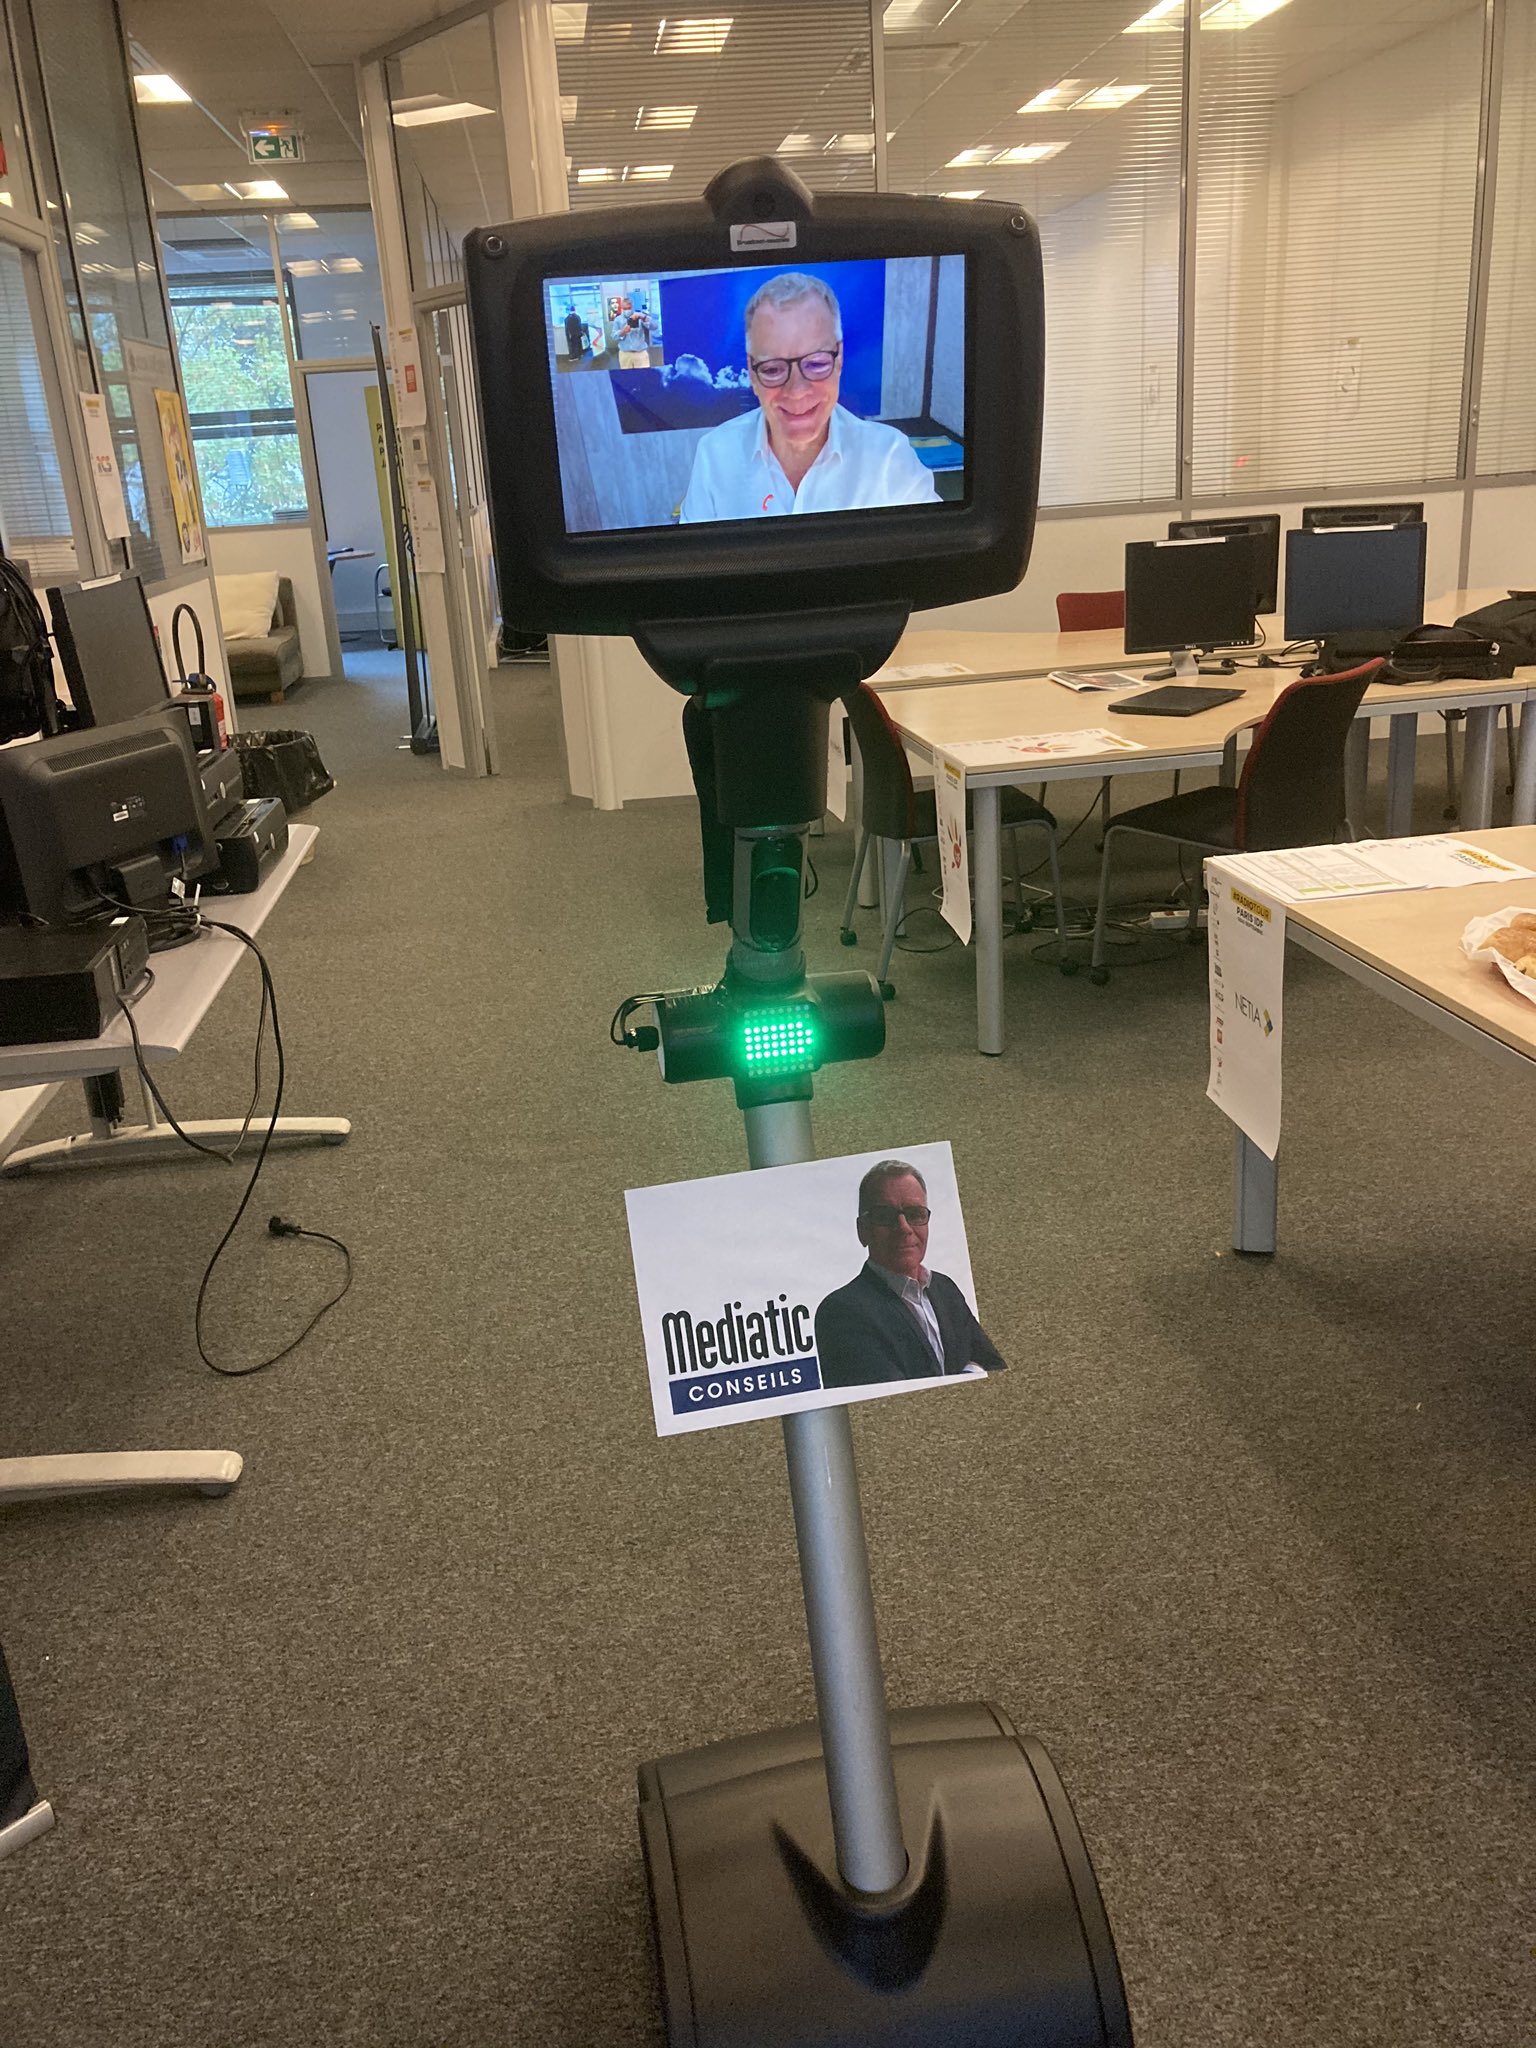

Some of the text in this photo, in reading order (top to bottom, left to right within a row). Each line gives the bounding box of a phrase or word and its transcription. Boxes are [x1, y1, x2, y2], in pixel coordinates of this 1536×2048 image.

[1237, 906, 1253, 922] PARIS
[1235, 992, 1261, 1027] NETIA
[689, 1368, 802, 1401] CONSEILS
